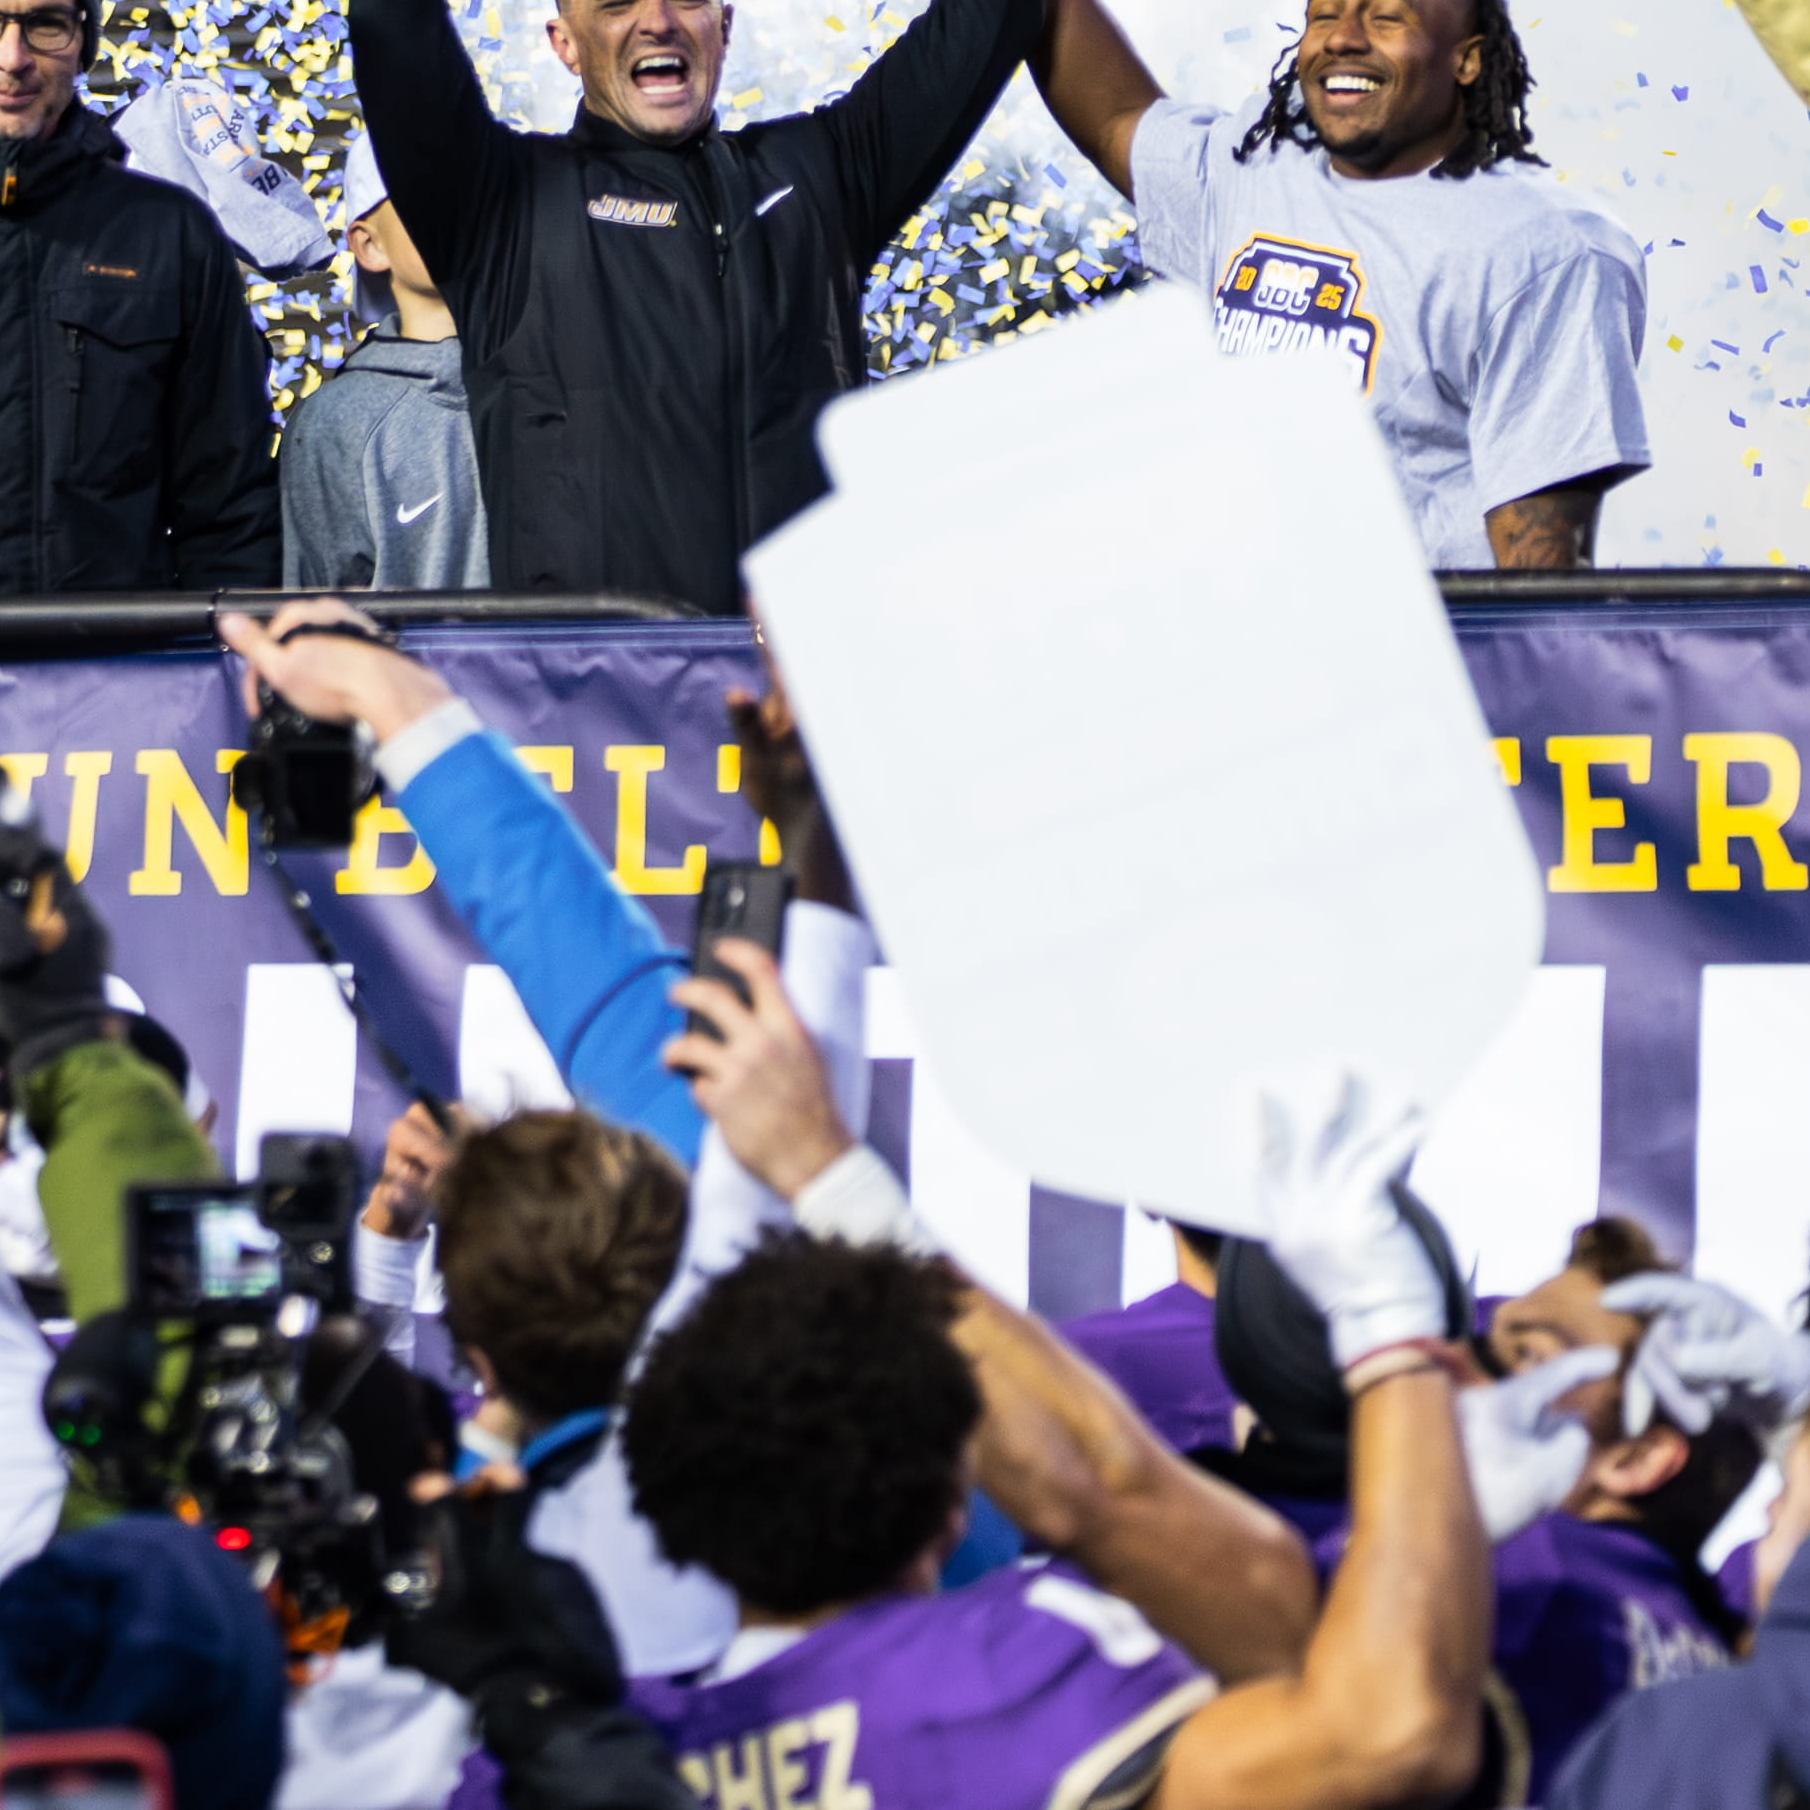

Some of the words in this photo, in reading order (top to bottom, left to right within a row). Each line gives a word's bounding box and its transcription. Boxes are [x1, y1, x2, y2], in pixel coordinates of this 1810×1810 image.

[588, 194, 678, 227] JMU
[1234, 265, 1257, 291] 20
[1253, 258, 1319, 316] SBC
[1315, 282, 1345, 310] 25
